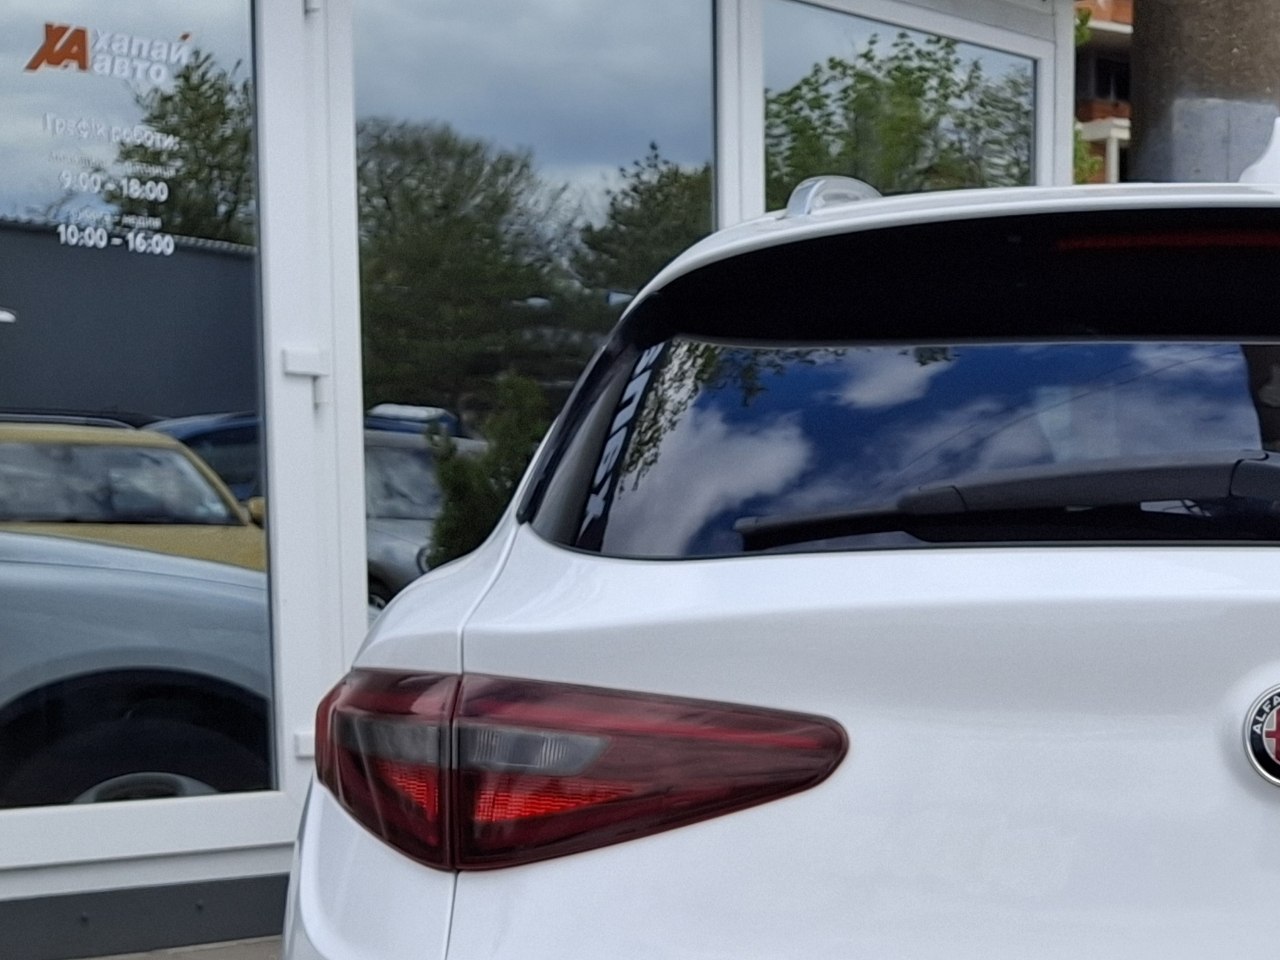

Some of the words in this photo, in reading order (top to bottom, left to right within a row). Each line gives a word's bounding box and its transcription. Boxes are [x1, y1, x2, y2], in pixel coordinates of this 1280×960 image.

[93, 30, 192, 65] хапай
[94, 53, 168, 83] авто
[121, 177, 169, 203] 18:00
[57, 223, 108, 249] 10:00
[126, 231, 175, 256] 16:00
